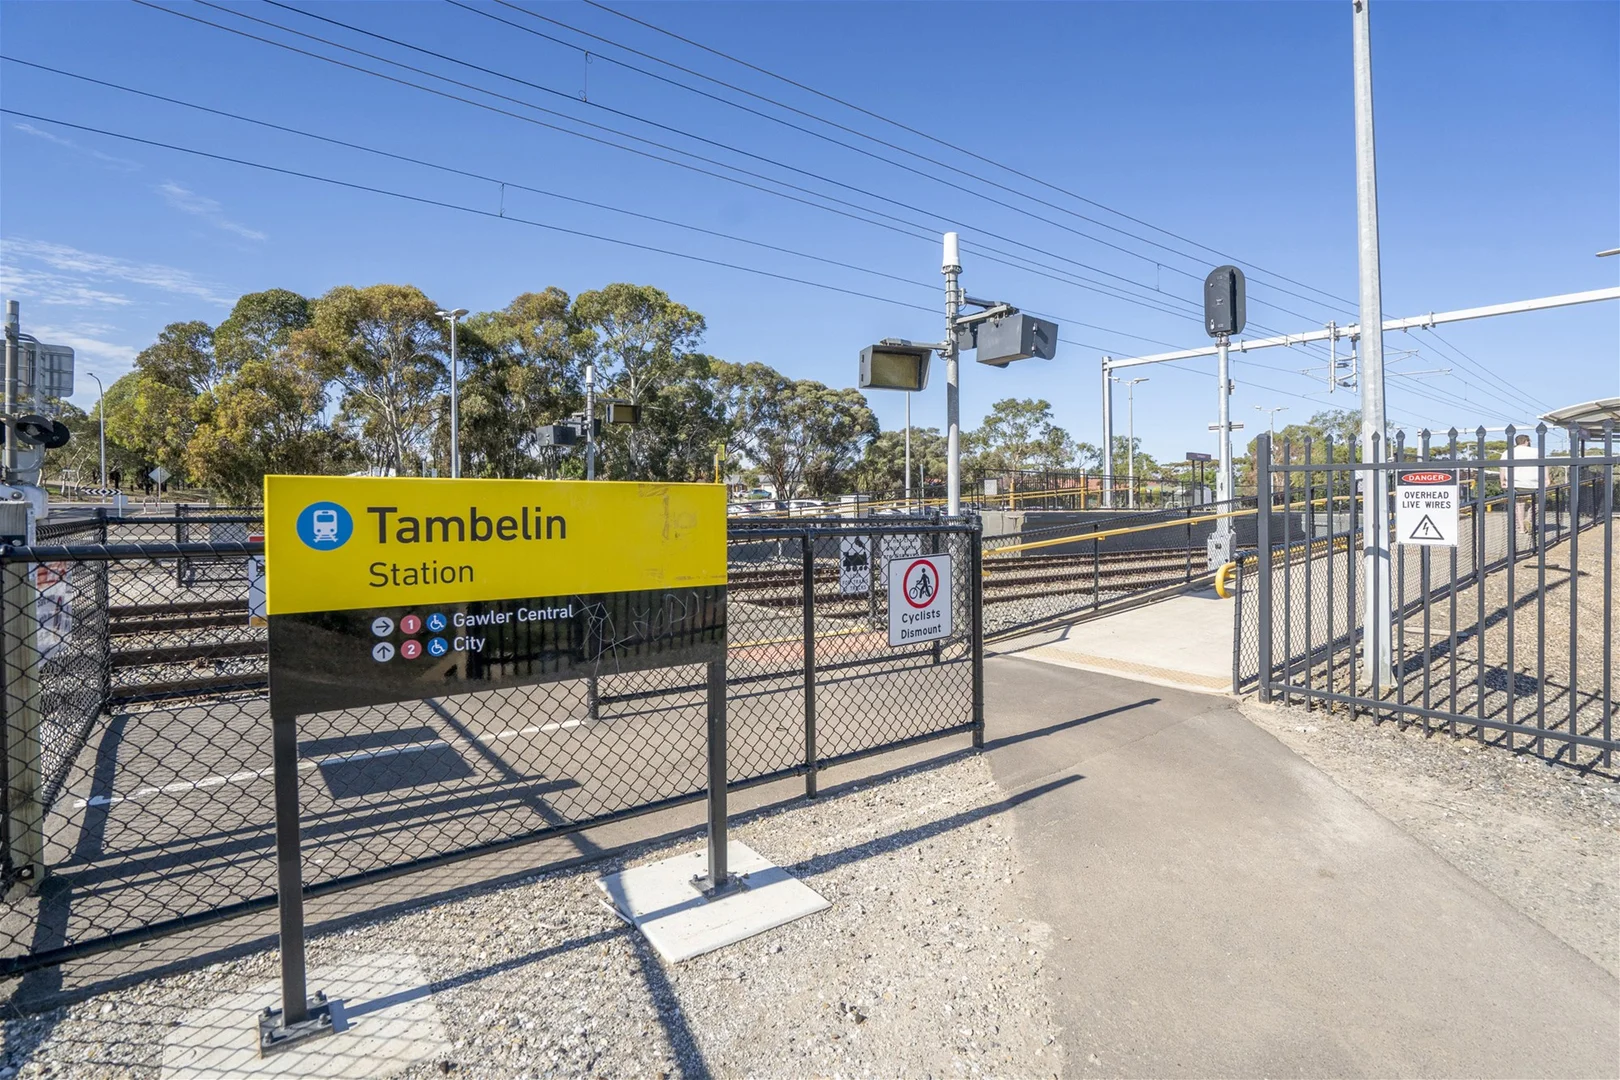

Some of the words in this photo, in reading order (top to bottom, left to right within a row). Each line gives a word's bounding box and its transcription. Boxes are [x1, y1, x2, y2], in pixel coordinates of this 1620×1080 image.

[1404, 491, 1449, 499] OVERHEAD
[1402, 501, 1421, 509] LIVE
[1424, 501, 1452, 509] WIRES
[366, 506, 567, 544] Tambelin
[369, 560, 474, 588] Station
[407, 619, 414, 630] 1
[453, 609, 513, 628] Gawler
[517, 604, 574, 622] Central
[901, 609, 941, 624] Cyclists
[901, 624, 942, 639] Dismount
[407, 644, 415, 655] 2
[453, 636, 486, 653] City
